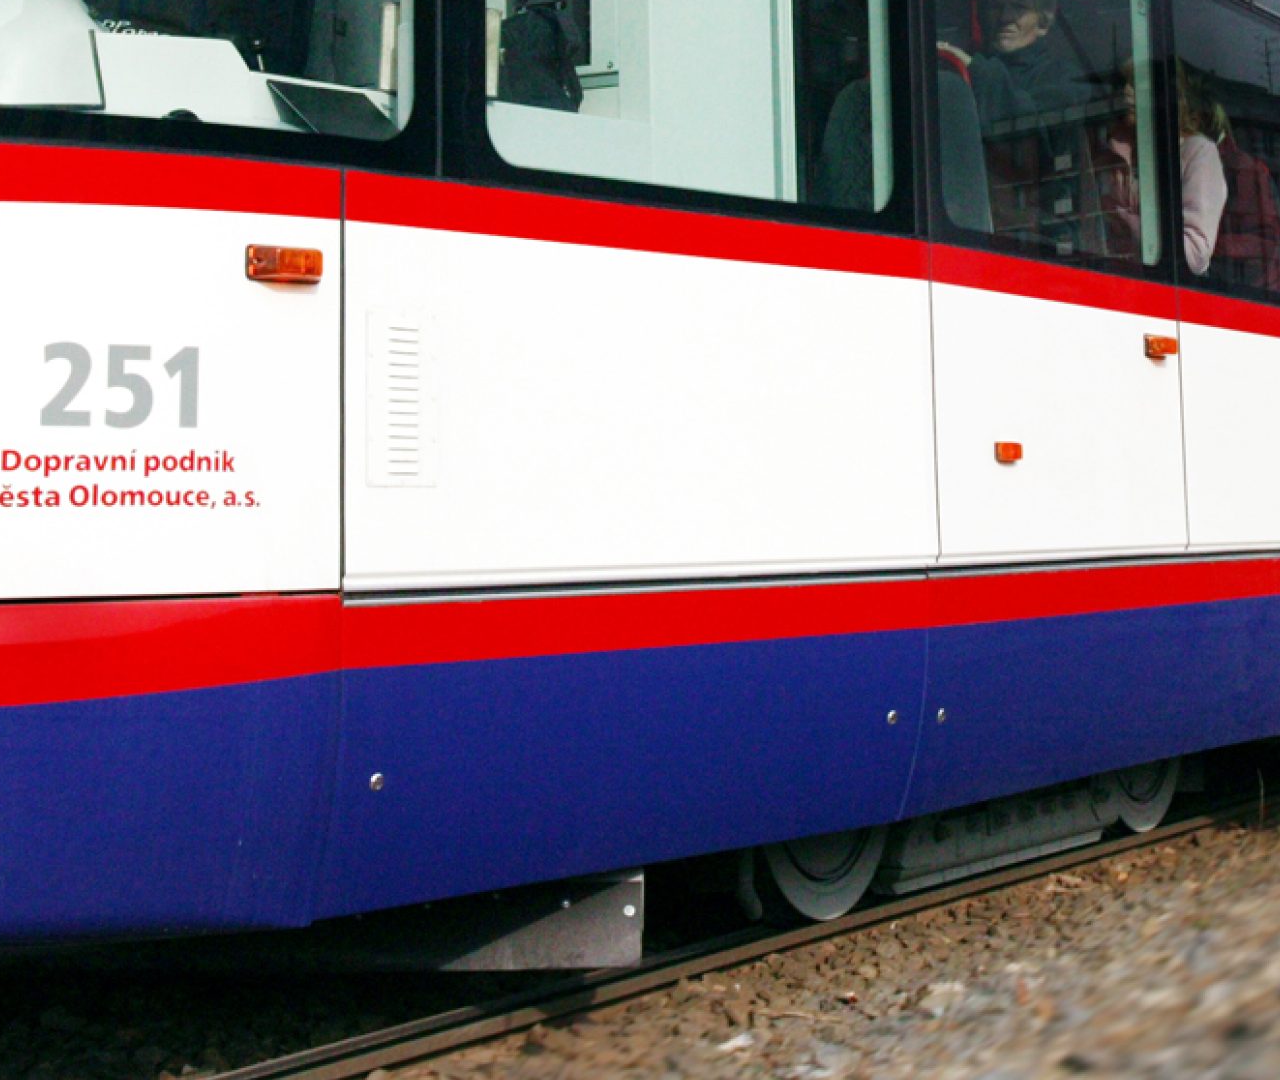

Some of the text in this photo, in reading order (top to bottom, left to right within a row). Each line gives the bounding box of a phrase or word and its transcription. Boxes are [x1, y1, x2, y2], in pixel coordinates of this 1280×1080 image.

[40, 341, 200, 429] 251
[0, 448, 236, 477] Dopravní podnik
[69, 483, 217, 509] Olomouce,
[223, 488, 261, 508] a.s.
